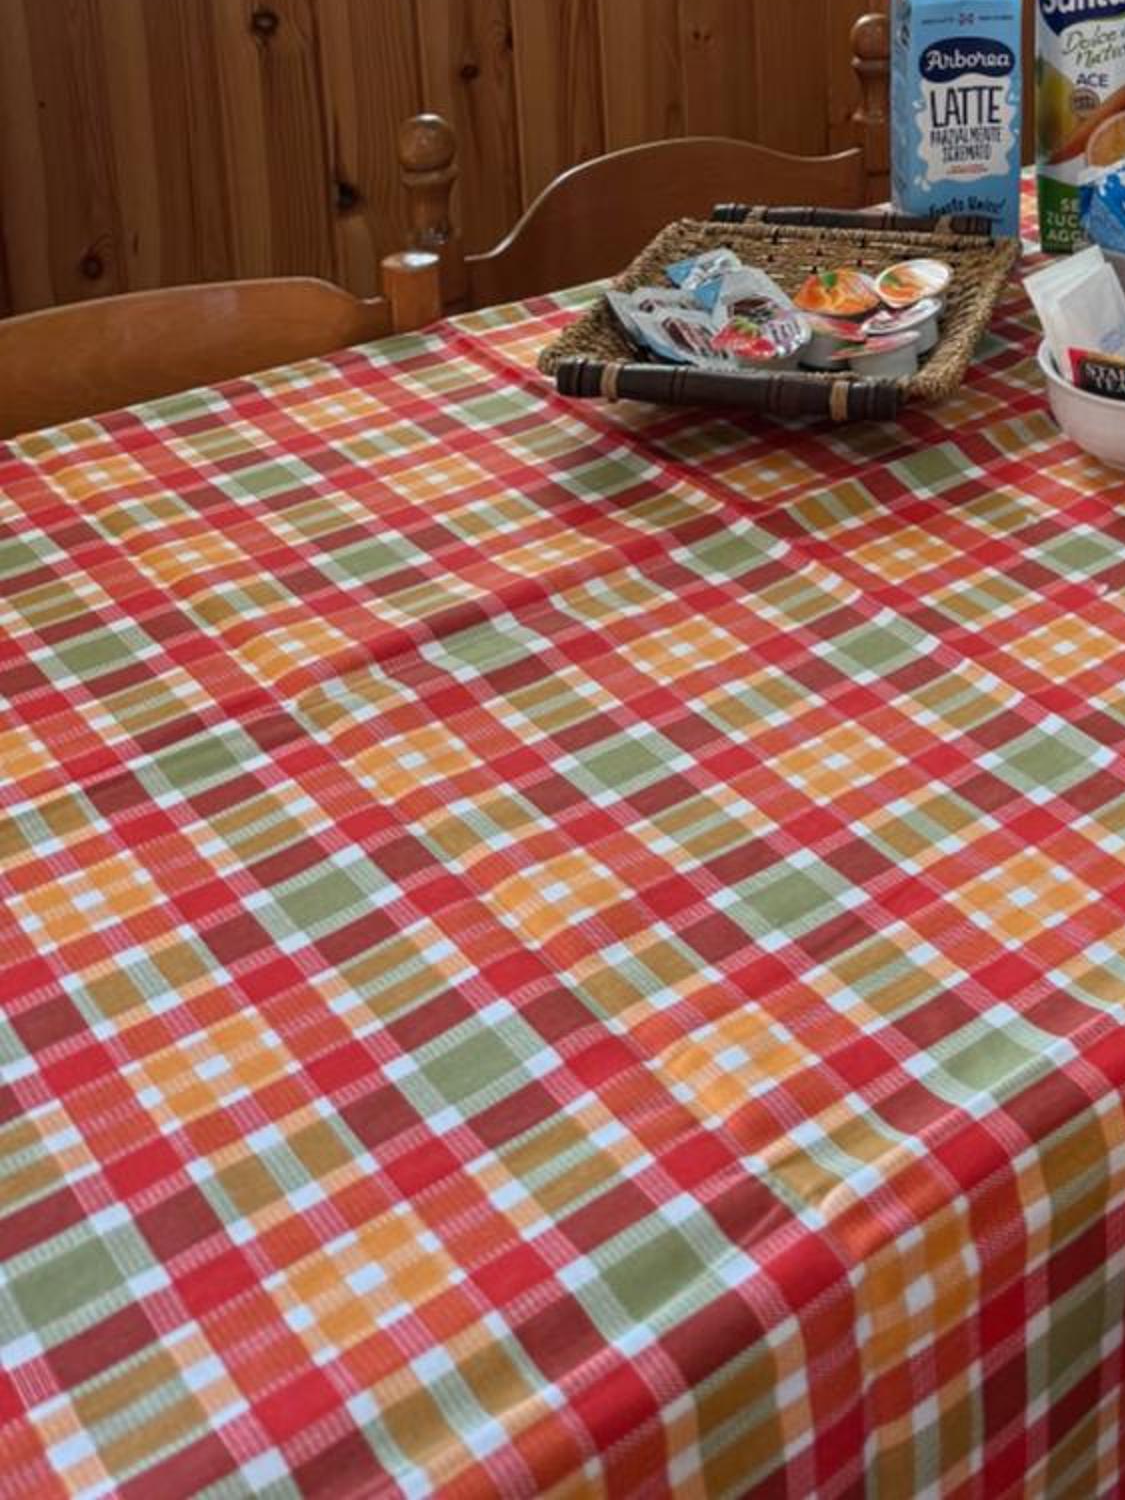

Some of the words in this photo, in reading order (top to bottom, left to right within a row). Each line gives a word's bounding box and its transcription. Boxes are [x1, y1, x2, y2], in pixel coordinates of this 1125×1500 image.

[926, 50, 1010, 72] Arborea
[1076, 72, 1109, 88] ACE
[930, 85, 1003, 128] LATTE
